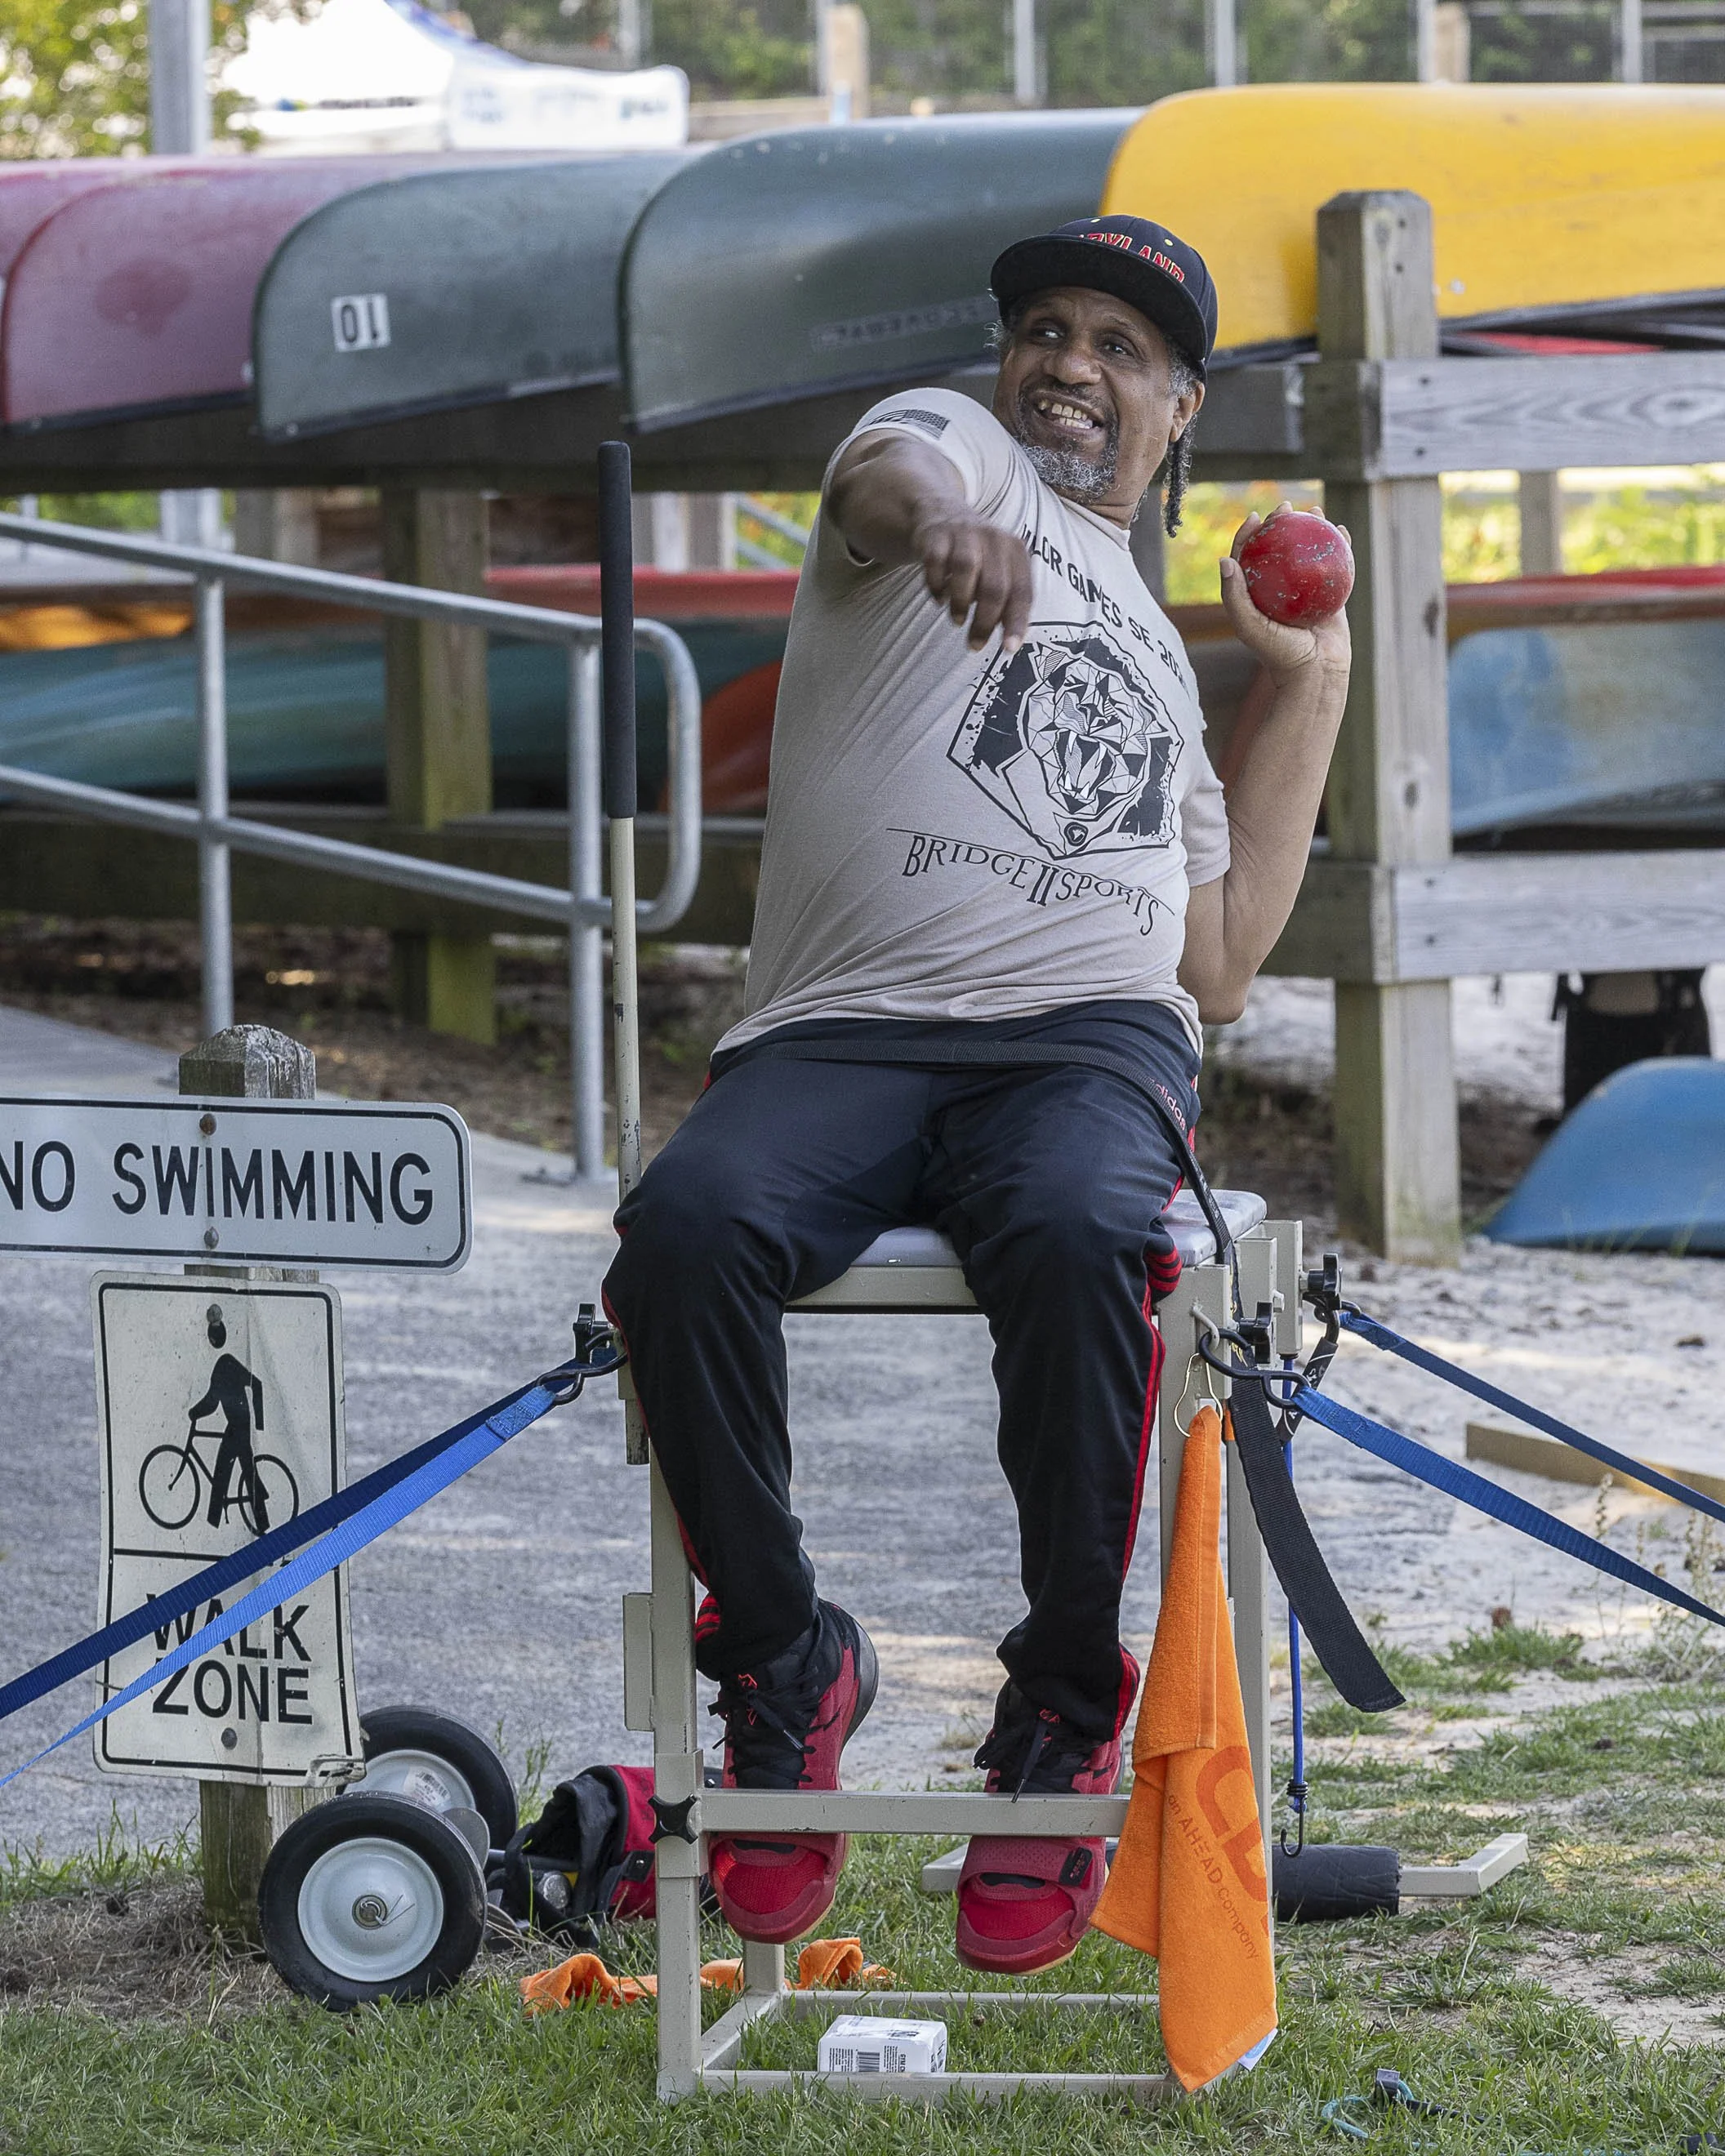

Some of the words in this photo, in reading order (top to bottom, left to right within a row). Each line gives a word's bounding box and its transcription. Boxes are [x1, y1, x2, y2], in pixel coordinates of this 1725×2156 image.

[1068, 563, 1123, 628] GAMES
[1128, 617, 1154, 653] SE
[902, 835, 1035, 889] BRIDGE
[1055, 875, 1159, 937] SPORTS
[0, 1140, 75, 1213] NO
[112, 1143, 434, 1225] SWIMMING
[152, 1657, 313, 1725] ZONE
[1168, 1795, 1181, 1815] an
[1178, 1816, 1224, 1884] AHEAD
